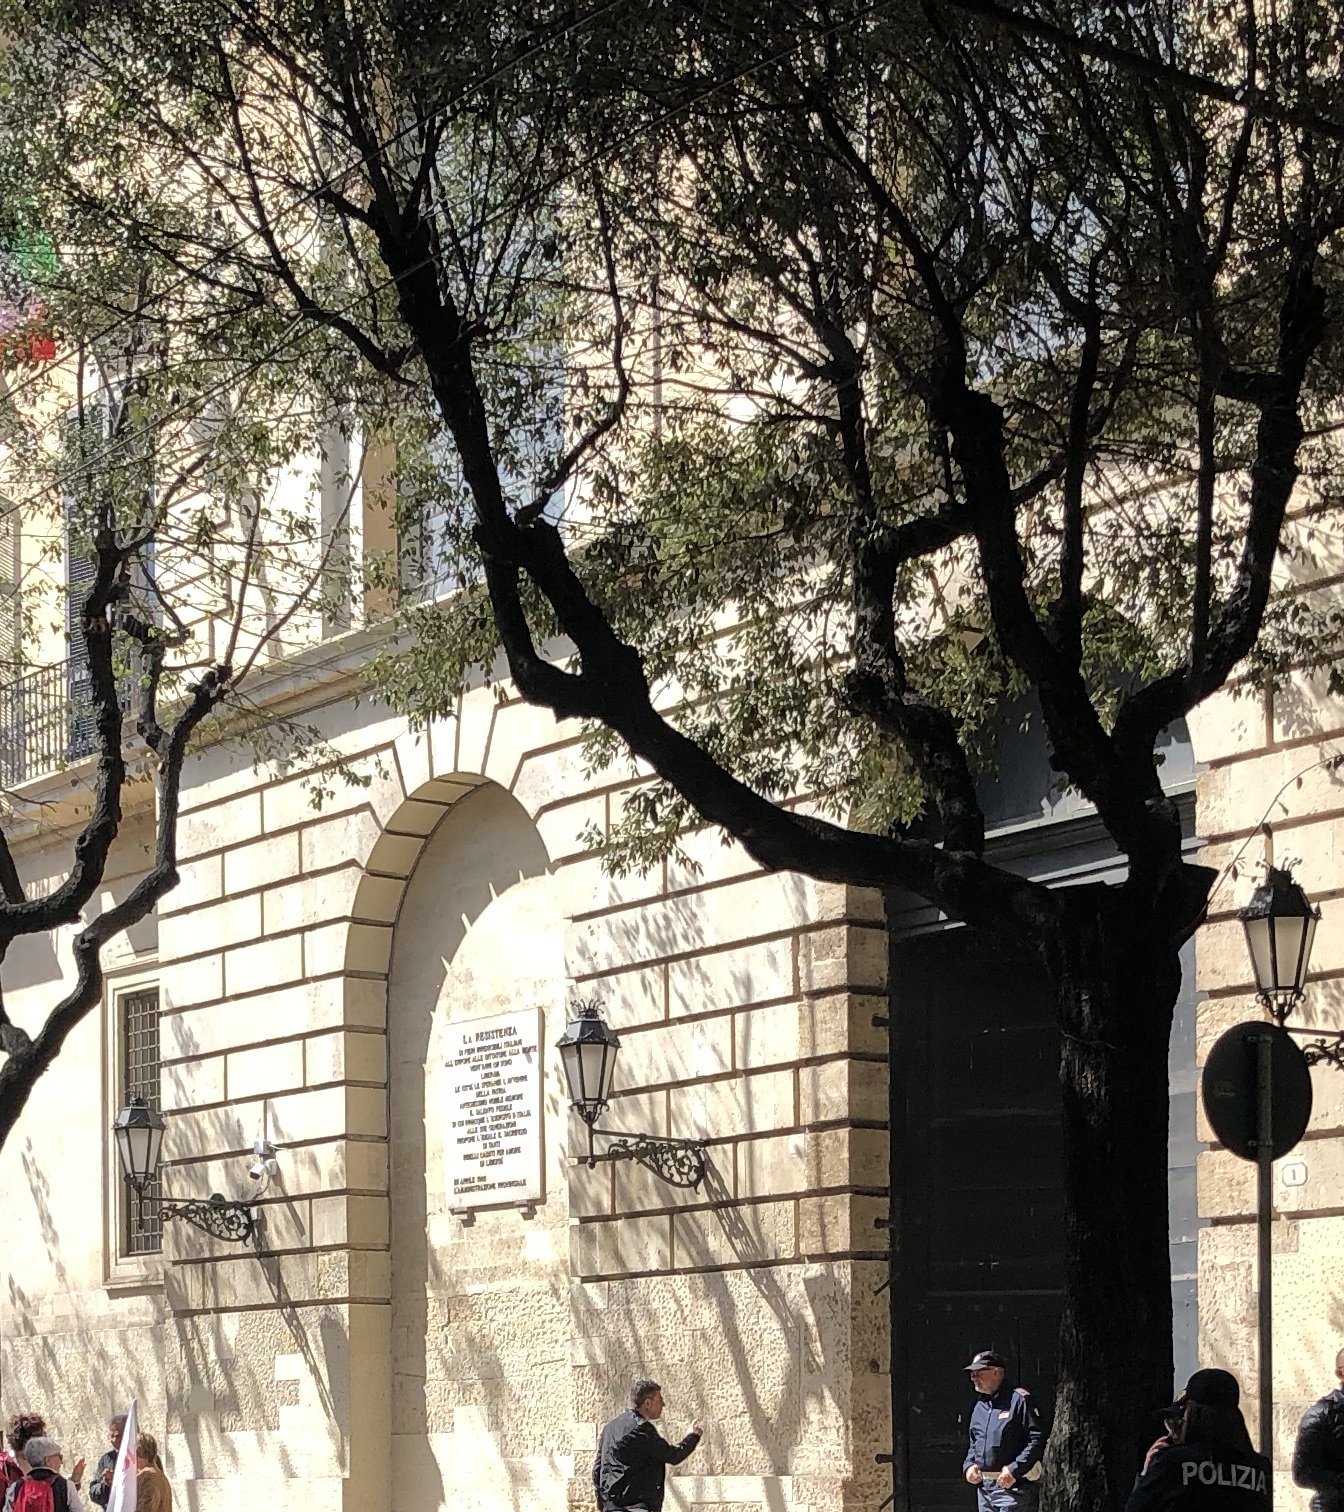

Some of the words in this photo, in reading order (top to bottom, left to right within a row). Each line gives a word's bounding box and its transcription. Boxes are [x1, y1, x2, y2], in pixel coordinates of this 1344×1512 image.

[476, 1026, 517, 1042] RESISTENZA
[1292, 1169, 1297, 1180] 1
[1181, 1460, 1268, 1495] POLIZIA
